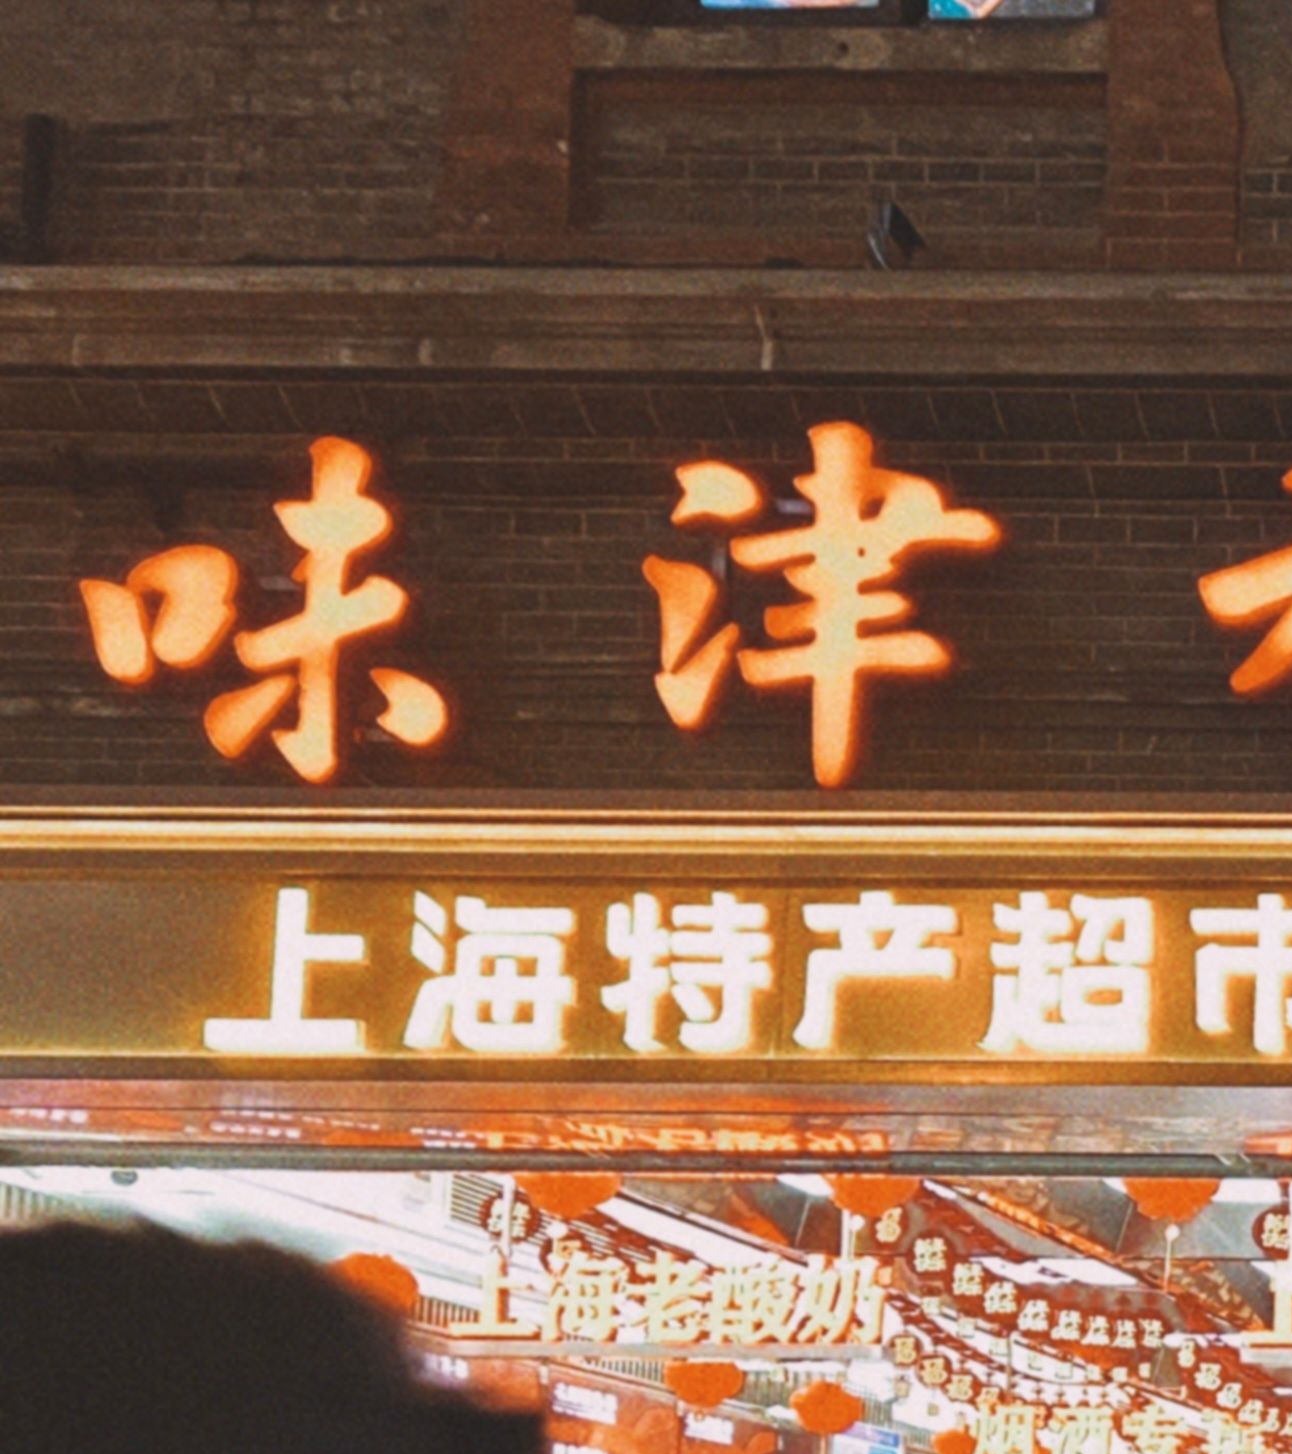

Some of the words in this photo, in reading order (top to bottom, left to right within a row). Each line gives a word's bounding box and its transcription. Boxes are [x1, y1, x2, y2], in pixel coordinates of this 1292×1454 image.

[449, 1247, 886, 1343] 上海老酸奶
